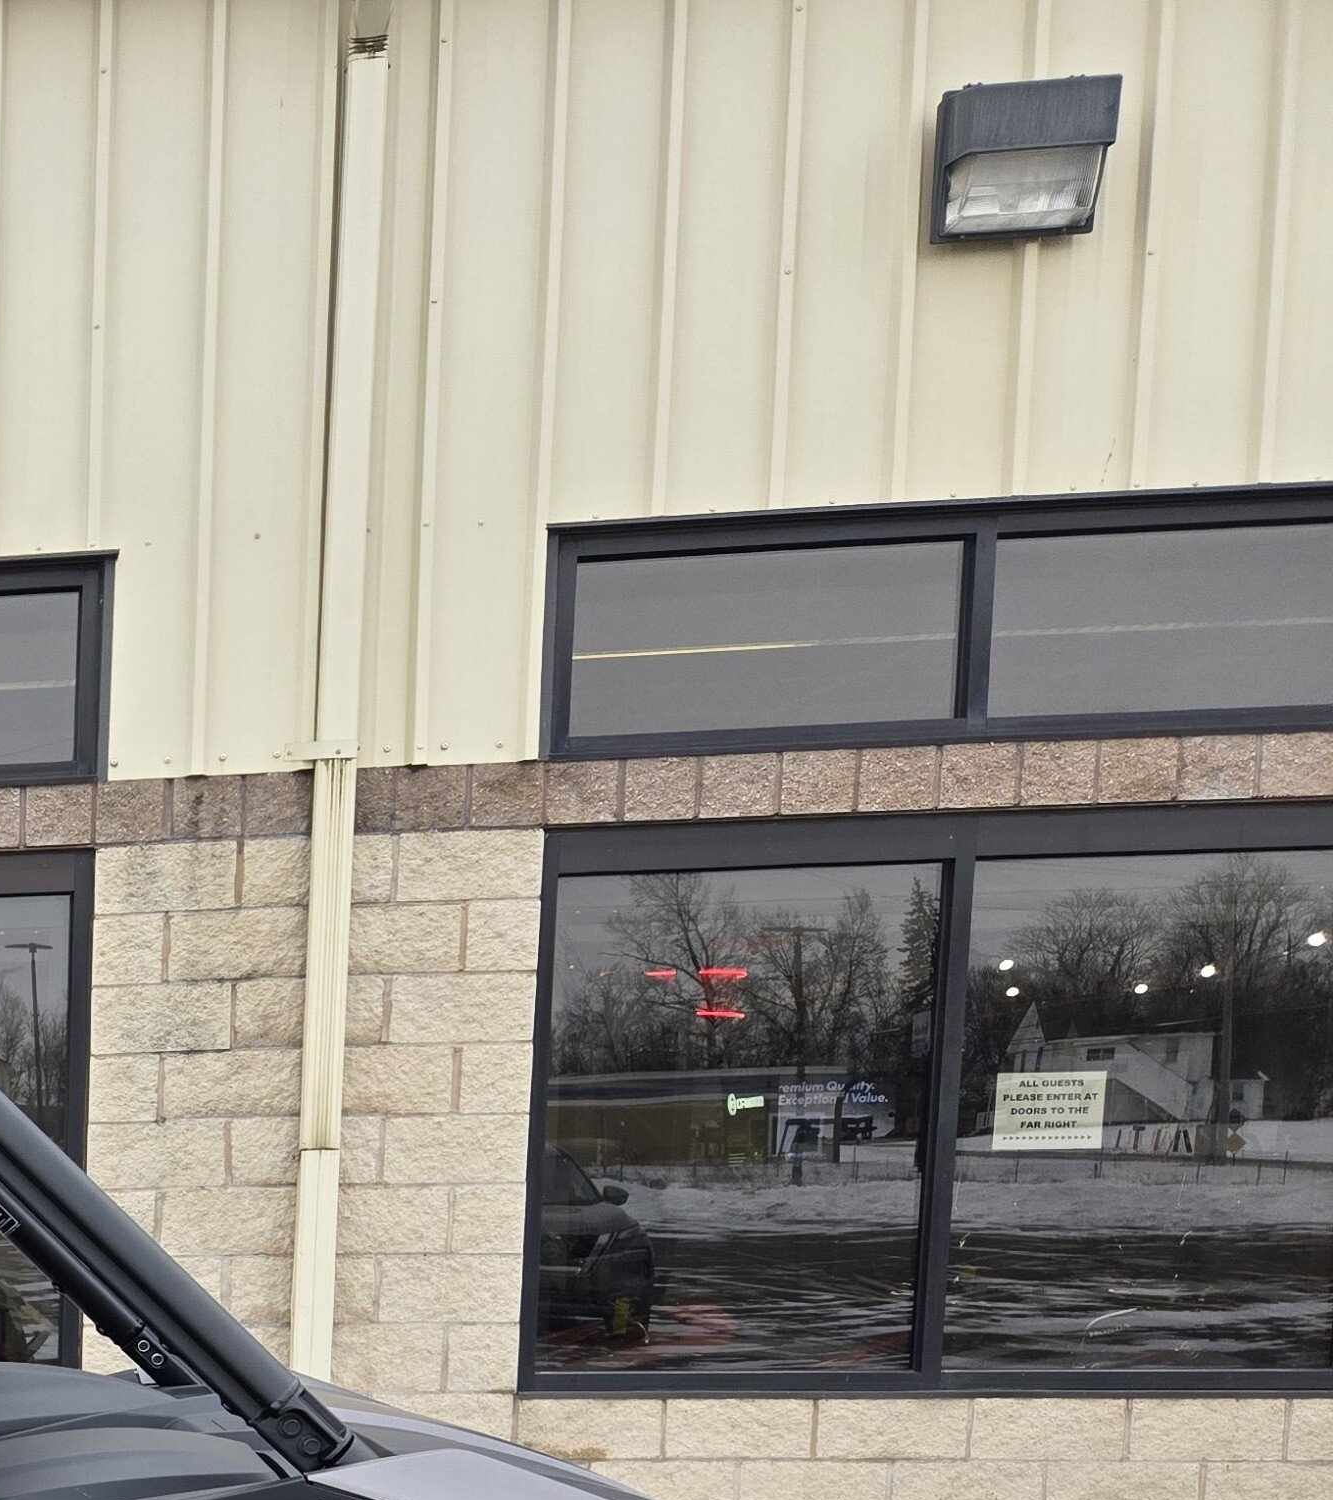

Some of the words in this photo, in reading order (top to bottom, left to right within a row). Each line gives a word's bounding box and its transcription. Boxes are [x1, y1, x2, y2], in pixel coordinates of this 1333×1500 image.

[778, 1080, 824, 1093] remium
[1018, 1080, 1039, 1088] ALL
[1041, 1079, 1085, 1088] GUESTS
[1002, 1093, 1044, 1102] PLEASE
[1046, 1093, 1082, 1101] ENTER
[1083, 1092, 1099, 1100] AT
[1010, 1107, 1048, 1115] DOORS
[1050, 1107, 1065, 1115] TO
[1067, 1106, 1090, 1114] THE
[1019, 1120, 1041, 1129] FAR
[1044, 1120, 1078, 1128] RIGHT
